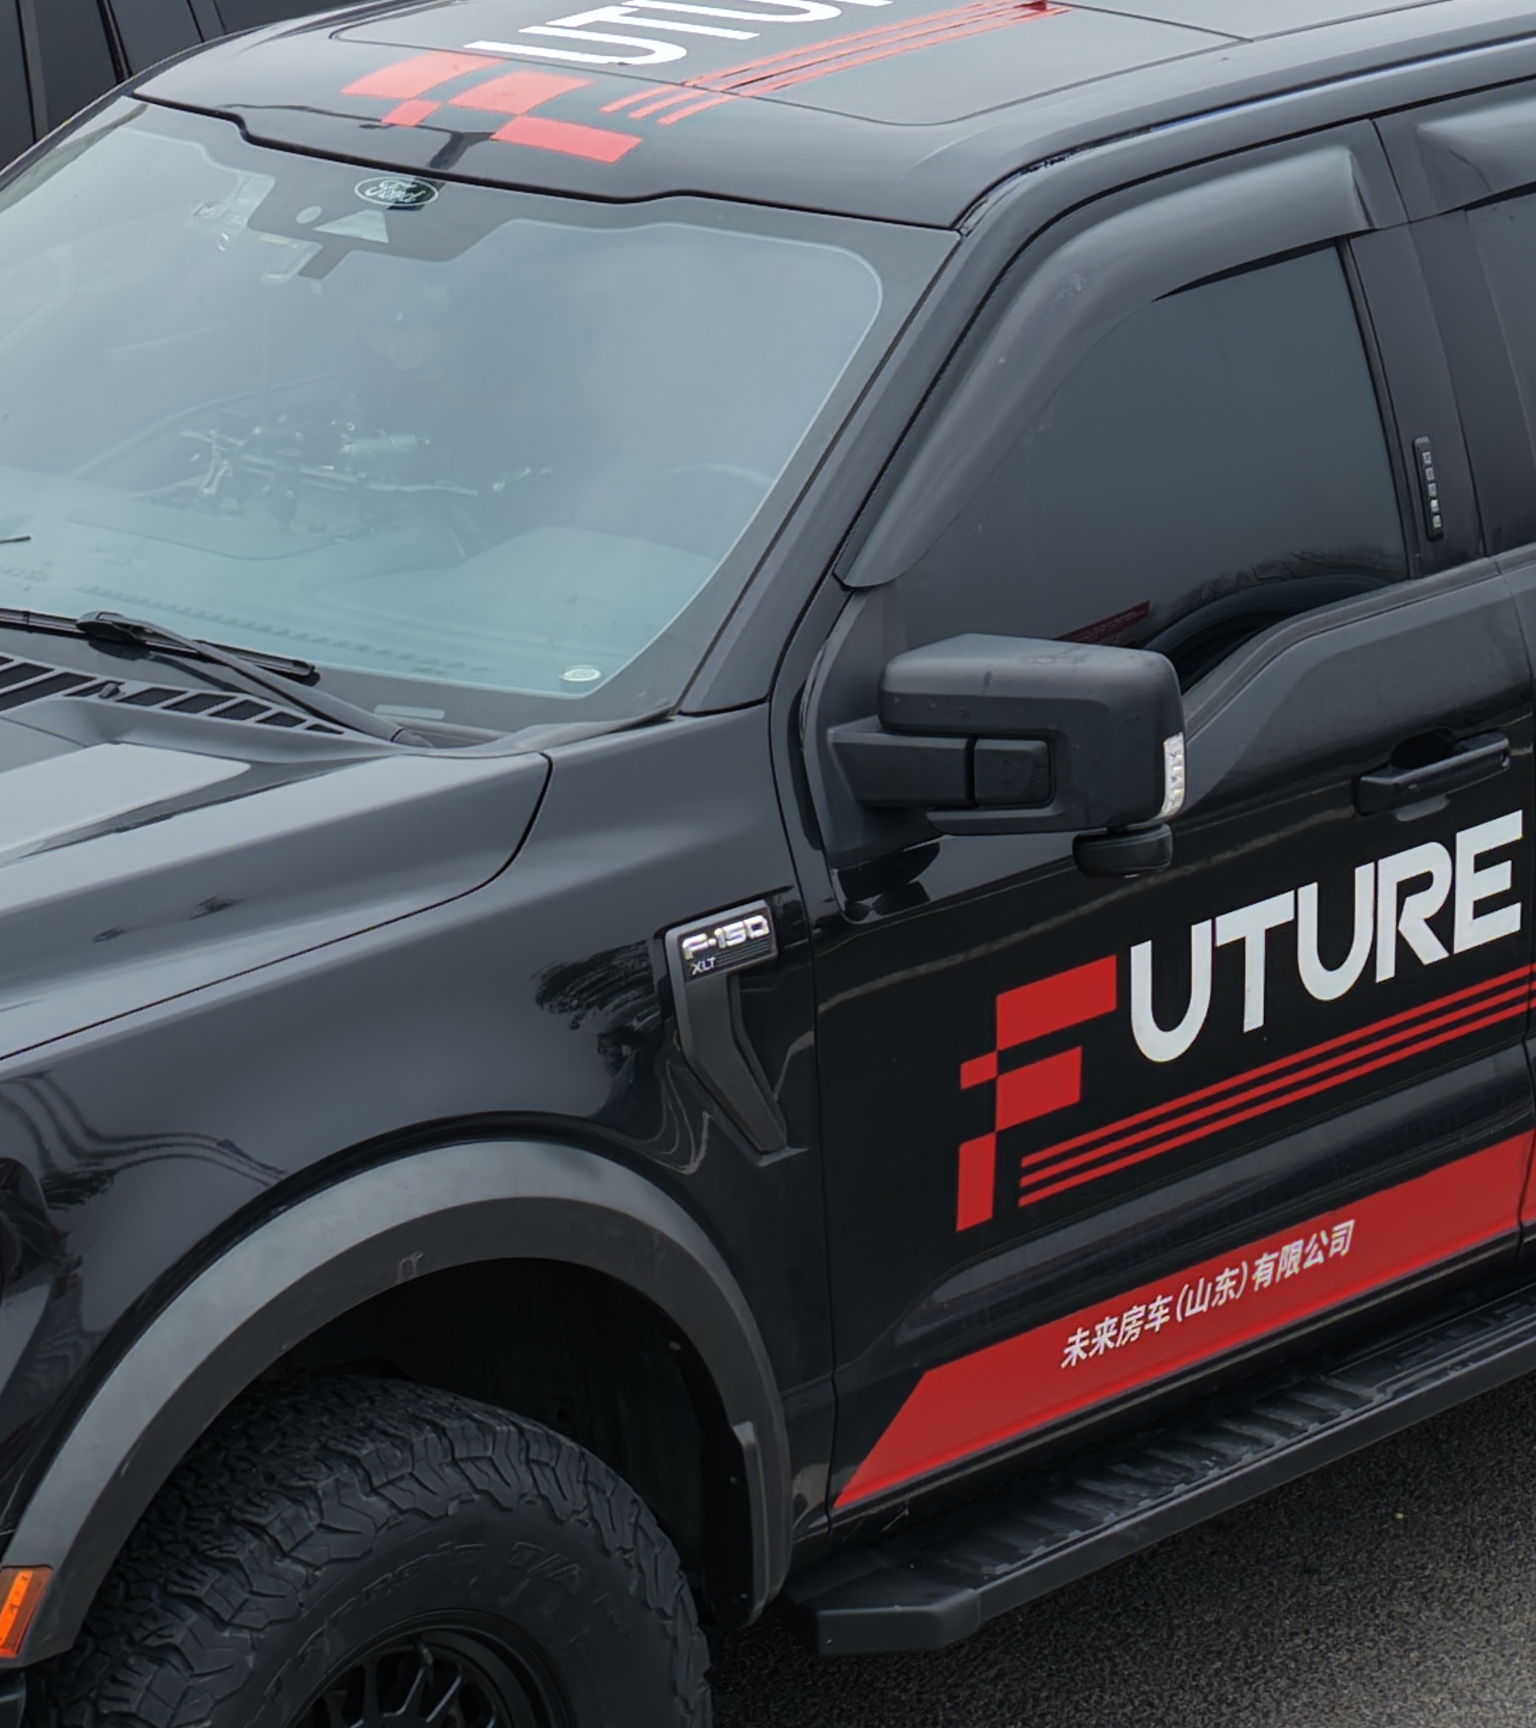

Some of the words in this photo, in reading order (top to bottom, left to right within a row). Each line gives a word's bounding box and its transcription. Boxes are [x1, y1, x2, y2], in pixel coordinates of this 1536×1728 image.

[682, 914, 771, 960] F-150
[691, 956, 716, 975] XLT
[955, 807, 1524, 1232] FUTURE
[1060, 1219, 1356, 1369] 未来房车(山东)有限公司
